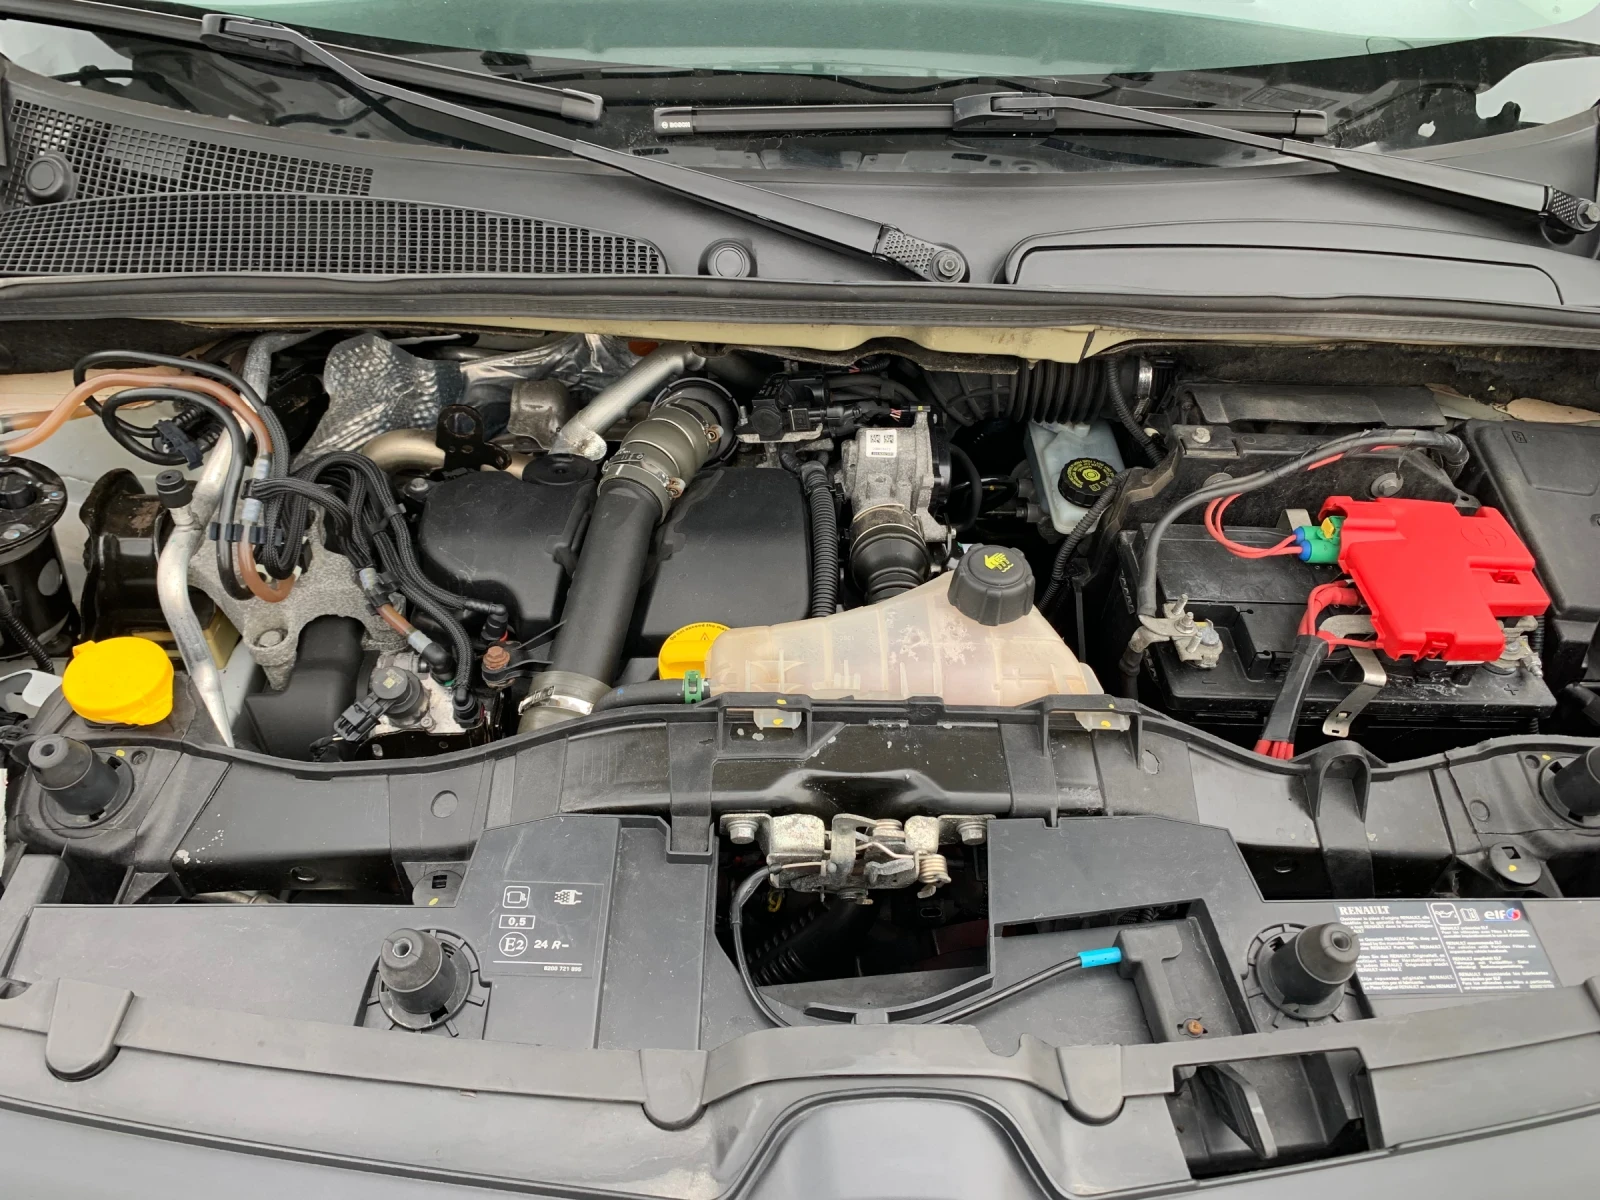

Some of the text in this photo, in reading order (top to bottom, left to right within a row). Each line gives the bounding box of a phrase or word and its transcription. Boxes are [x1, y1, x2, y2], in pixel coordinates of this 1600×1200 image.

[1338, 905, 1390, 915] RENAULT
[1483, 909, 1506, 920] elf
[508, 916, 527, 927] 0,5
[503, 937, 525, 952] E2
[533, 939, 549, 950] 24
